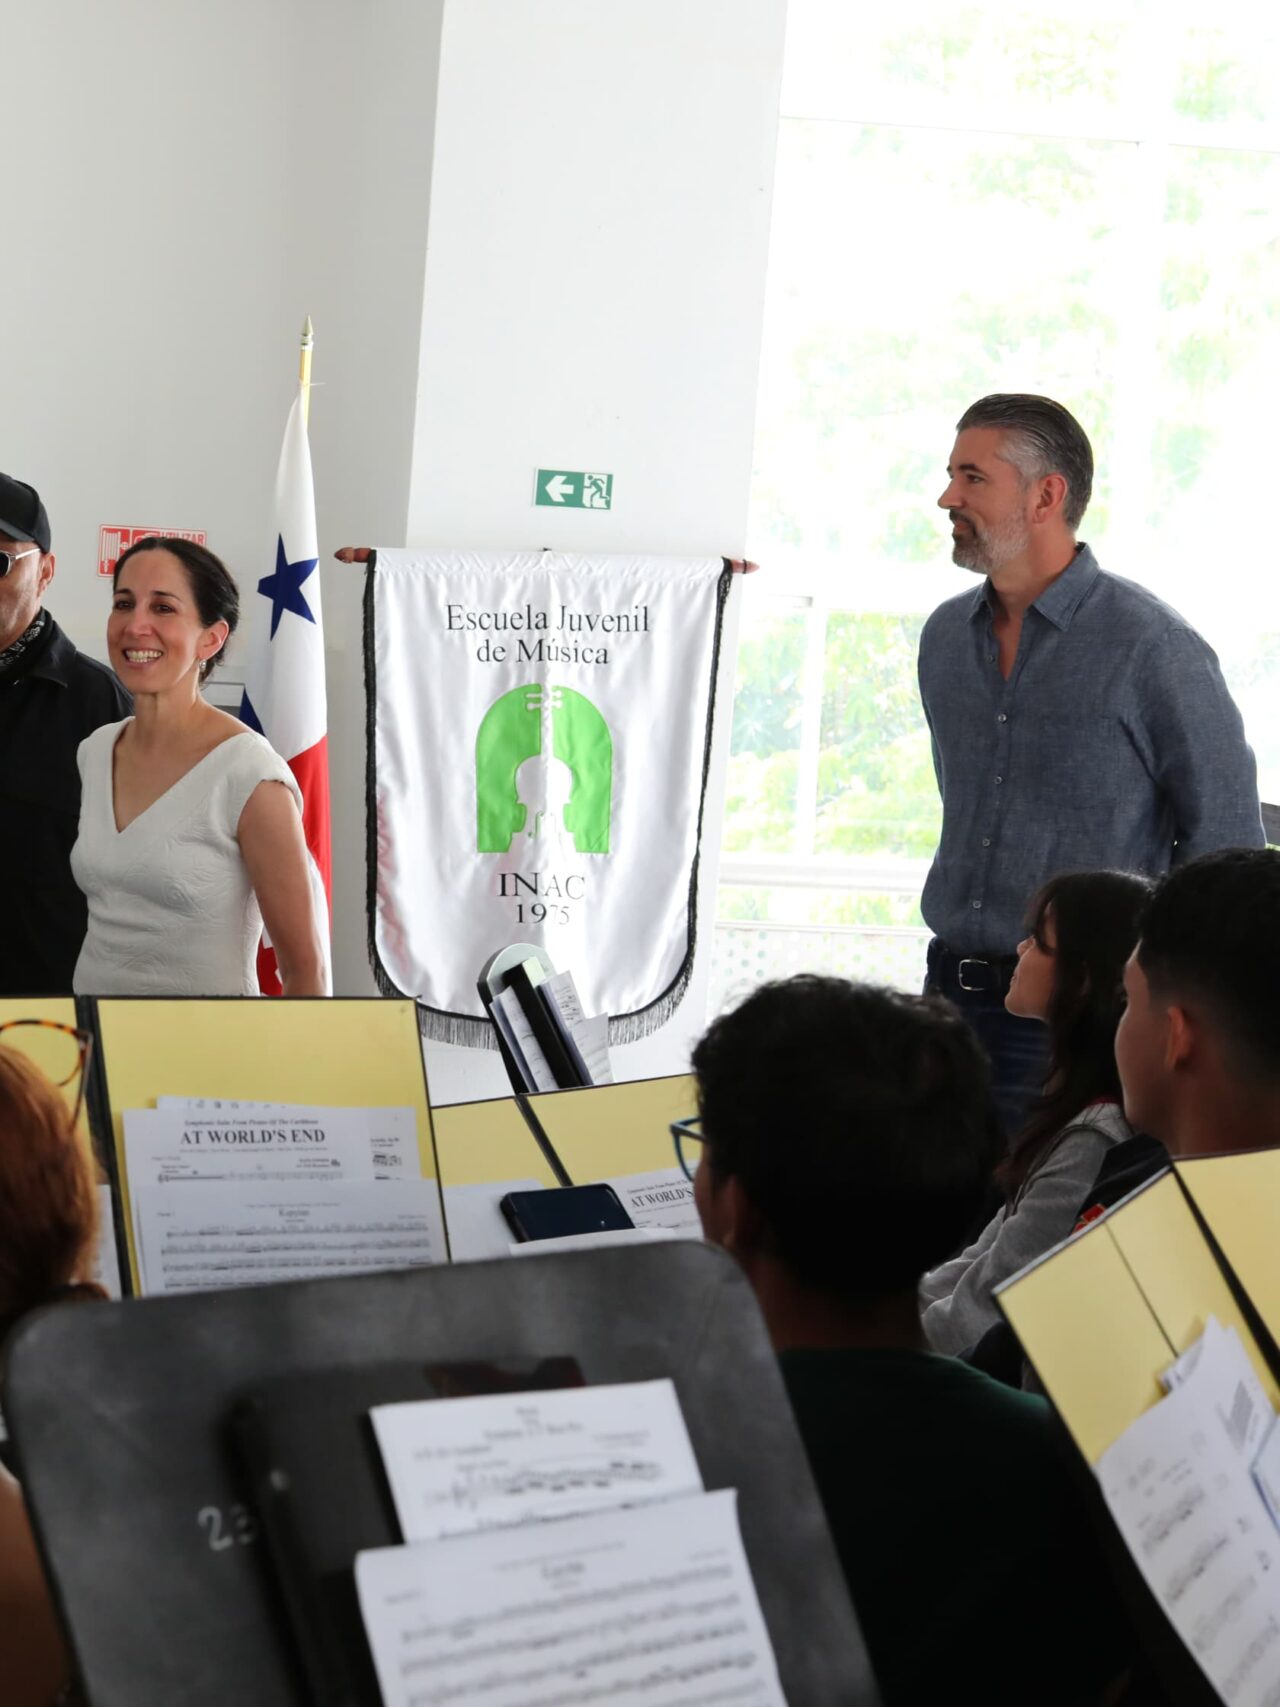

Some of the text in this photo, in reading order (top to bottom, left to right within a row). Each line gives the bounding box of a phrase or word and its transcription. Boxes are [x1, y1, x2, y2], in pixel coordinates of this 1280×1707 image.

[446, 604, 650, 632] Escuela Juvenil
[477, 638, 609, 664] de Música
[497, 872, 585, 900] INAC
[516, 903, 569, 925] 1975
[180, 1128, 325, 1145] AT WORLD'S END
[631, 1196, 645, 1208] AT
